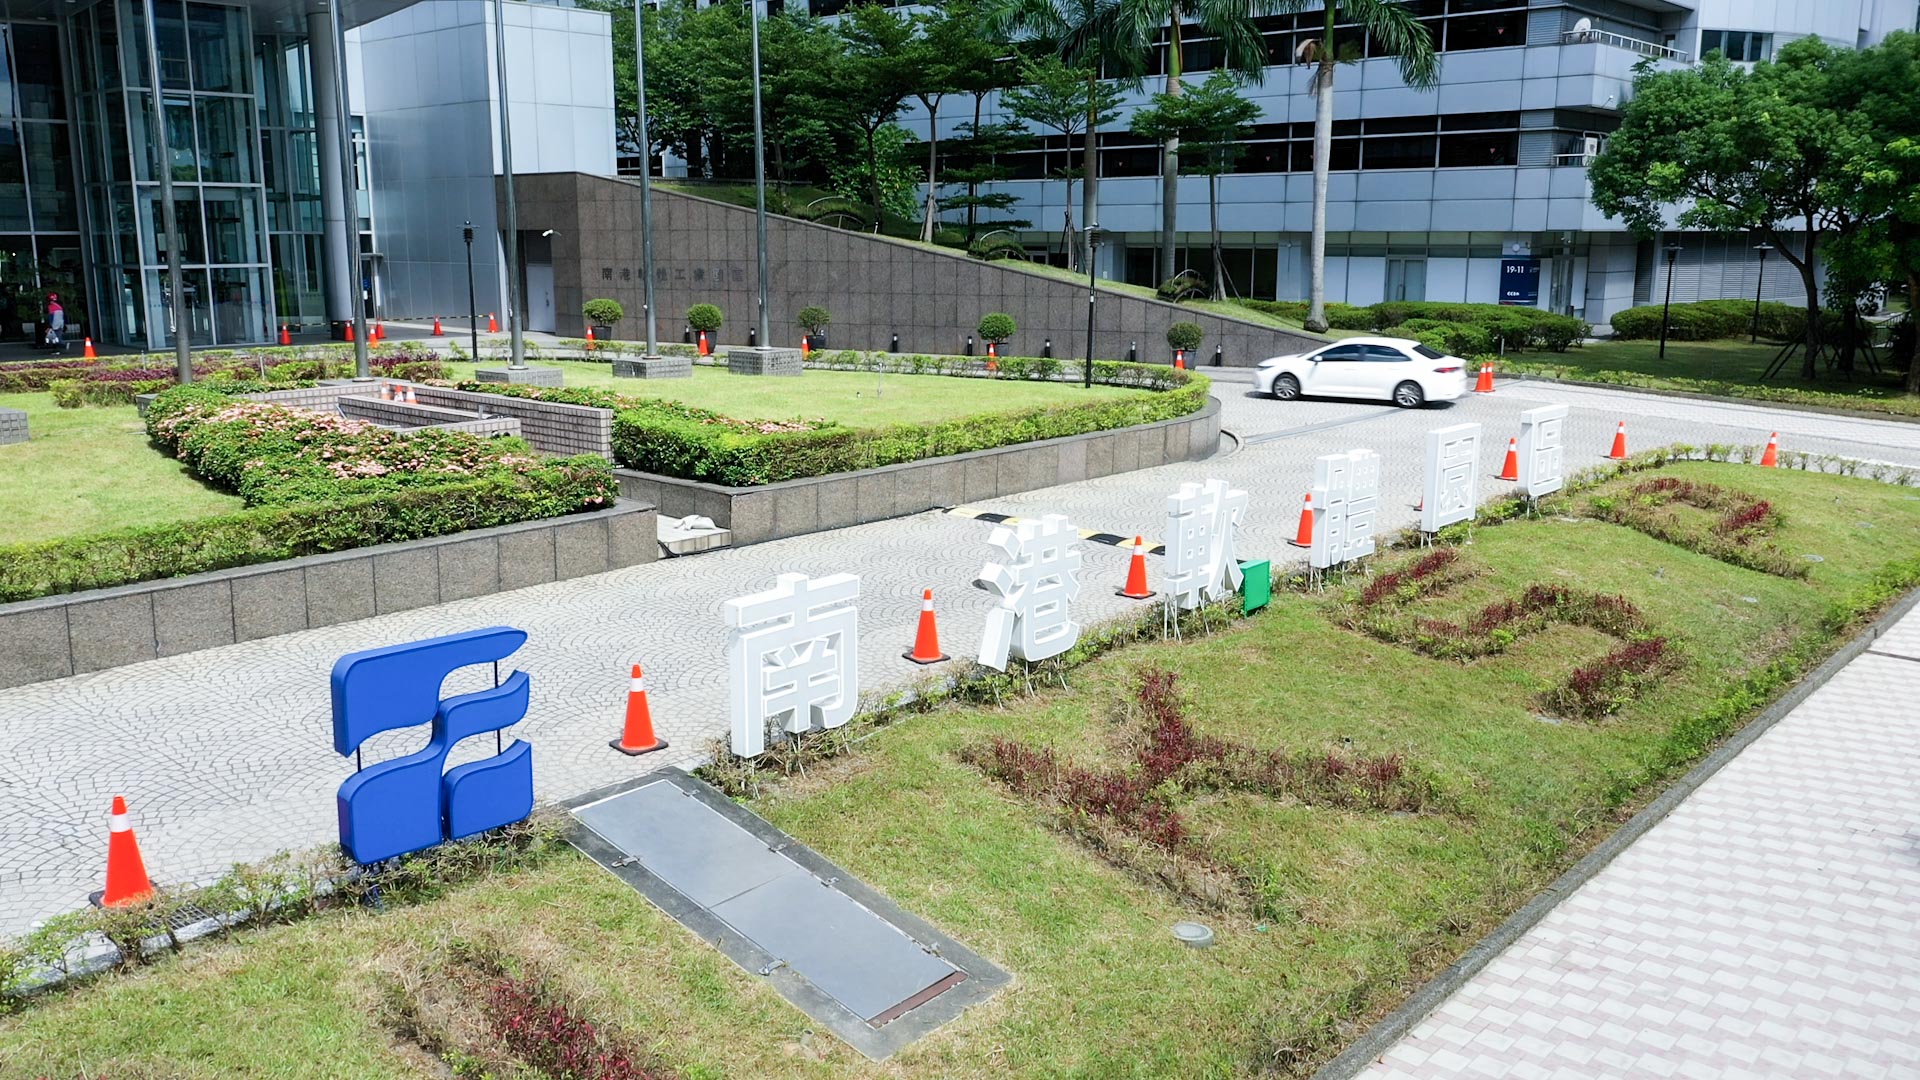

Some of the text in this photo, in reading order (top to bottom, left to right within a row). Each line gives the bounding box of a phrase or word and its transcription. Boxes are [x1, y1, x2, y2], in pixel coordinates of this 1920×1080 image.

[724, 404, 1568, 759] 南港軟體園區
